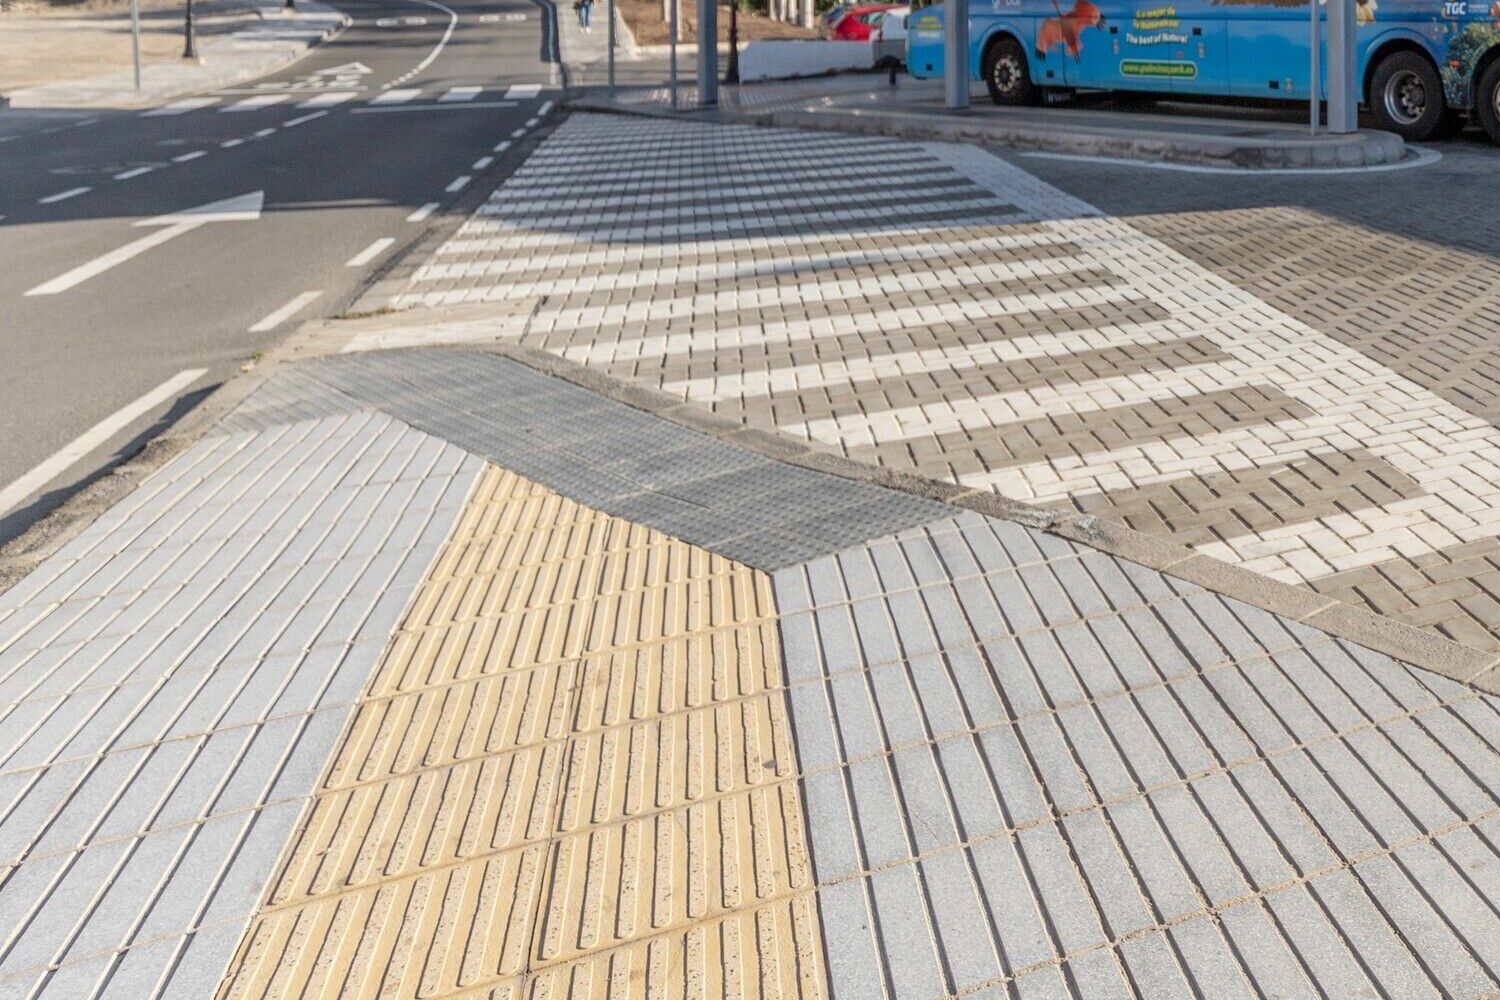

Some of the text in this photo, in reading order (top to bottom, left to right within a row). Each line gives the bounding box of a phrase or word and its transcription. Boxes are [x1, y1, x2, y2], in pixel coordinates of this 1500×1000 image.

[1445, 2, 1467, 15] TGC
[1126, 33, 1138, 44] The
[1139, 35, 1153, 45] best
[1154, 33, 1161, 43] of
